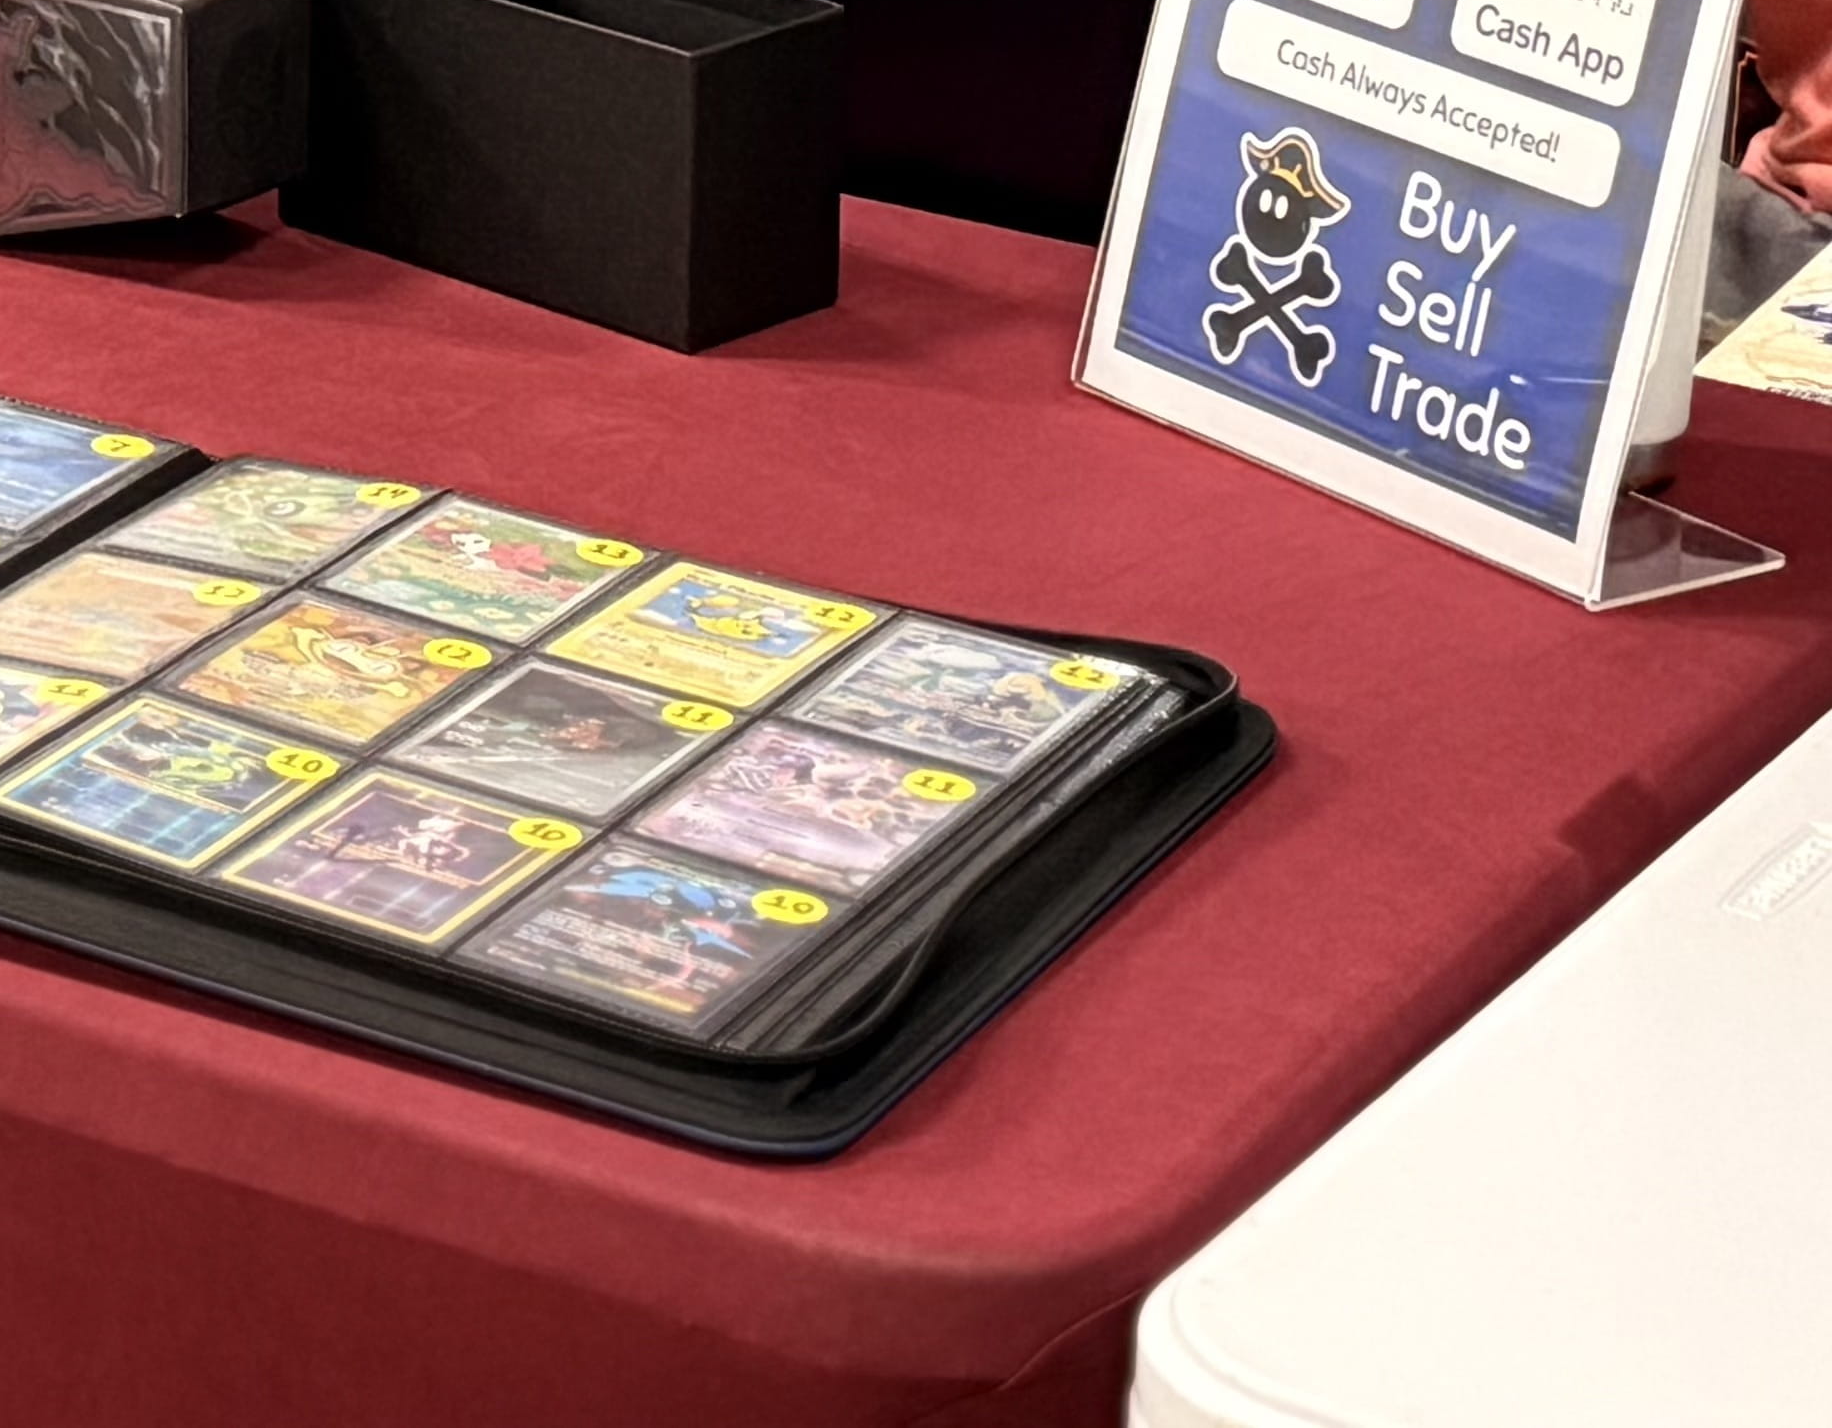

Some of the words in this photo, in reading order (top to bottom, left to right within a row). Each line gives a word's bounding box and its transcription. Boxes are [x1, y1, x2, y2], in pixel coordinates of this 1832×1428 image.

[1475, 4, 1551, 57] Cash
[1558, 32, 1624, 85] App
[1276, 39, 1335, 81] Cash
[1340, 61, 1427, 115] Always
[1431, 94, 1561, 163] Accepted!
[1399, 170, 1517, 283] Buy
[1378, 260, 1492, 357] Sell
[1368, 343, 1531, 470] Trade
[671, 704, 713, 723] 11
[277, 753, 323, 773] 10
[913, 775, 957, 795] 11
[522, 821, 567, 841] 10
[763, 895, 815, 915] 10
